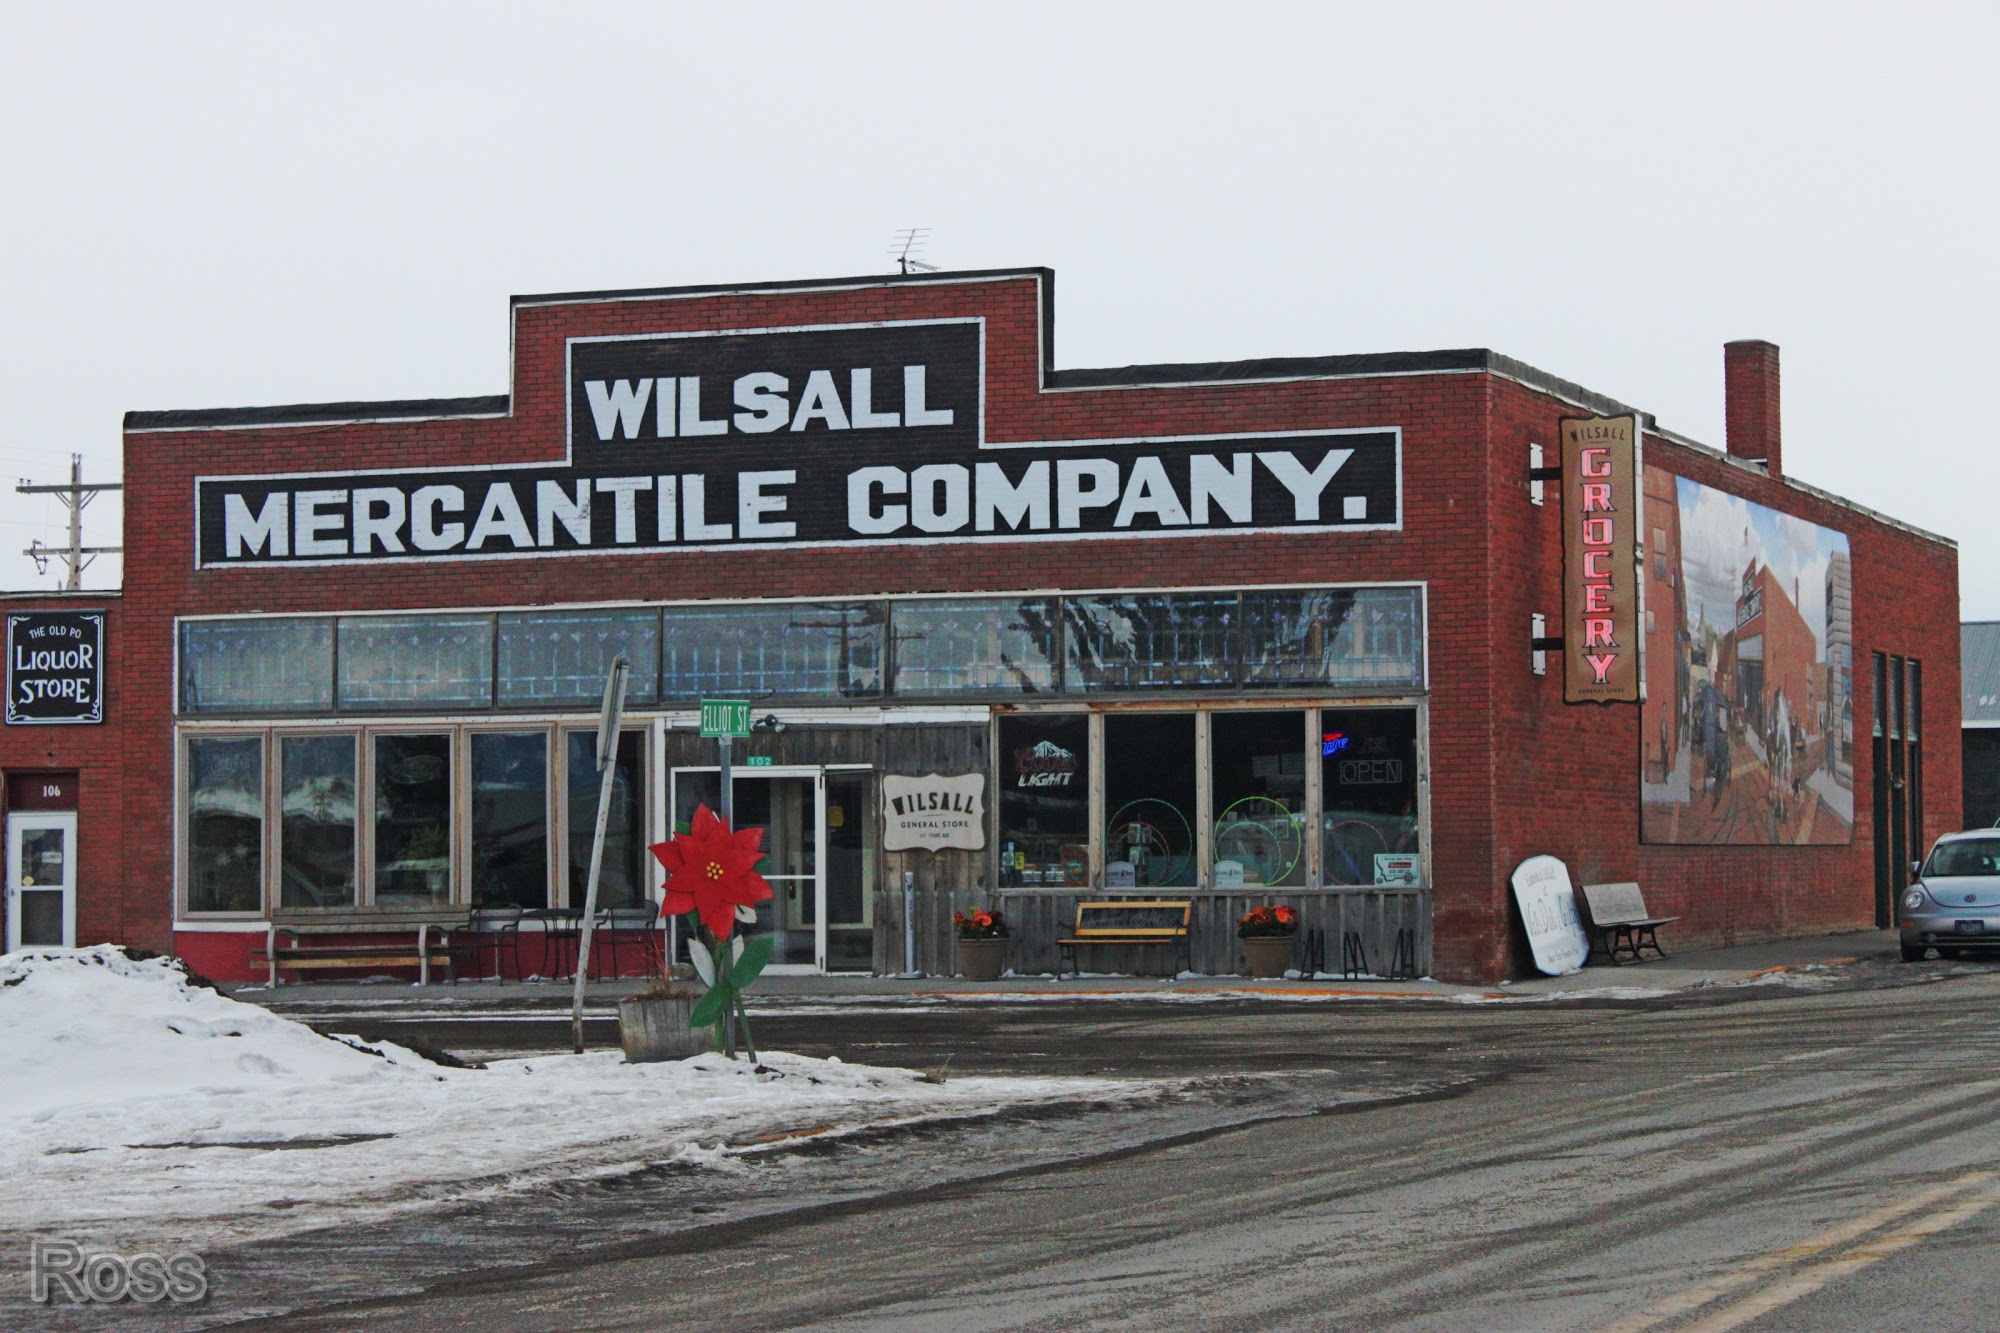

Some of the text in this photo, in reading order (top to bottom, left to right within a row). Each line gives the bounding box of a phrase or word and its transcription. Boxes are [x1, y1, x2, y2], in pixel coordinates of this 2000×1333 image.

[584, 364, 954, 441] WILSALL
[1570, 427, 1625, 442] WILSALL
[224, 448, 1367, 558] MERCANTILE COMPANY.
[1579, 448, 1620, 684] GROCERY
[29, 626, 45, 639] THE
[49, 625, 66, 636] OLD
[16, 644, 94, 672] LIQUOR
[18, 678, 91, 704] STORE
[703, 705, 748, 732] ELLIOT ST
[750, 757, 771, 766] 102
[1342, 761, 1400, 782] OPEN
[1018, 772, 1073, 787] LIGHT
[42, 785, 61, 798] 106
[891, 791, 973, 816] WILSALL
[901, 820, 968, 829] GENERAL STORE
